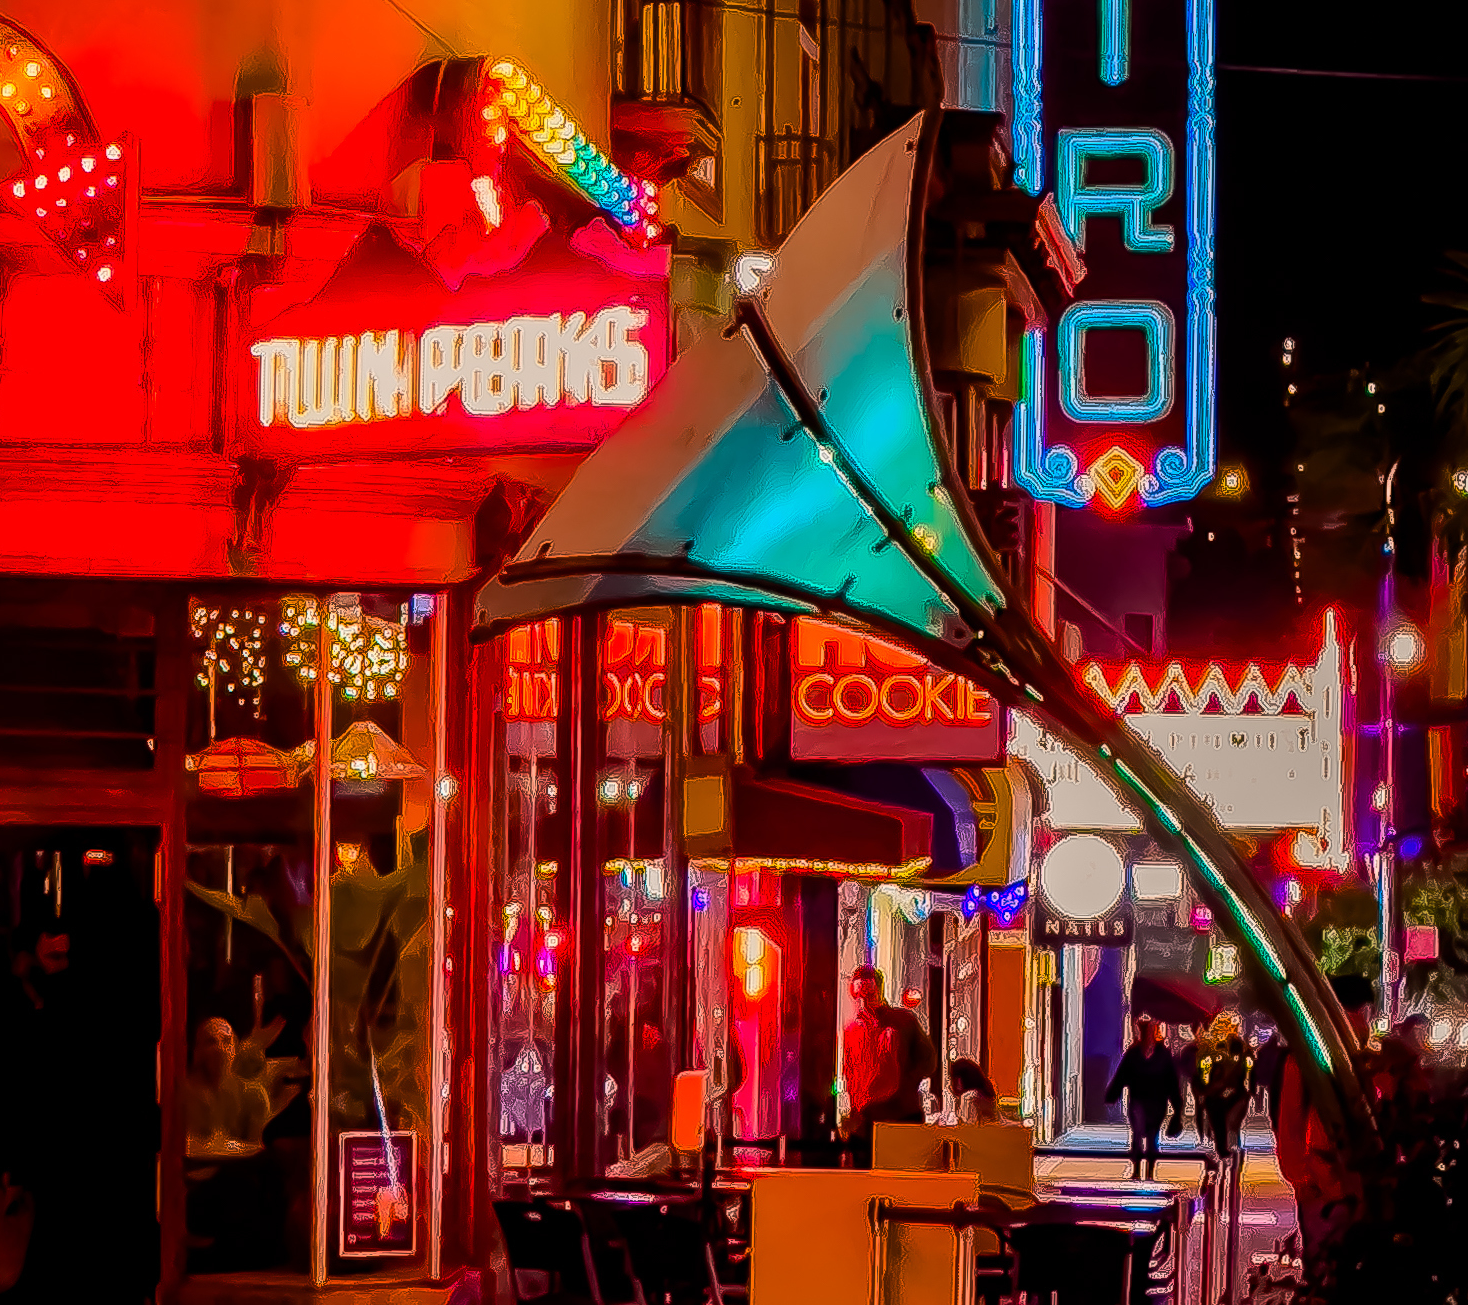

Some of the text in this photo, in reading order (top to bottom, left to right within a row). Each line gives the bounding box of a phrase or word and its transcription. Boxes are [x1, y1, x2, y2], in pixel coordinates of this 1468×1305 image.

[251, 304, 651, 428] TWIN PEAKS
[797, 672, 993, 722] COOKIE
